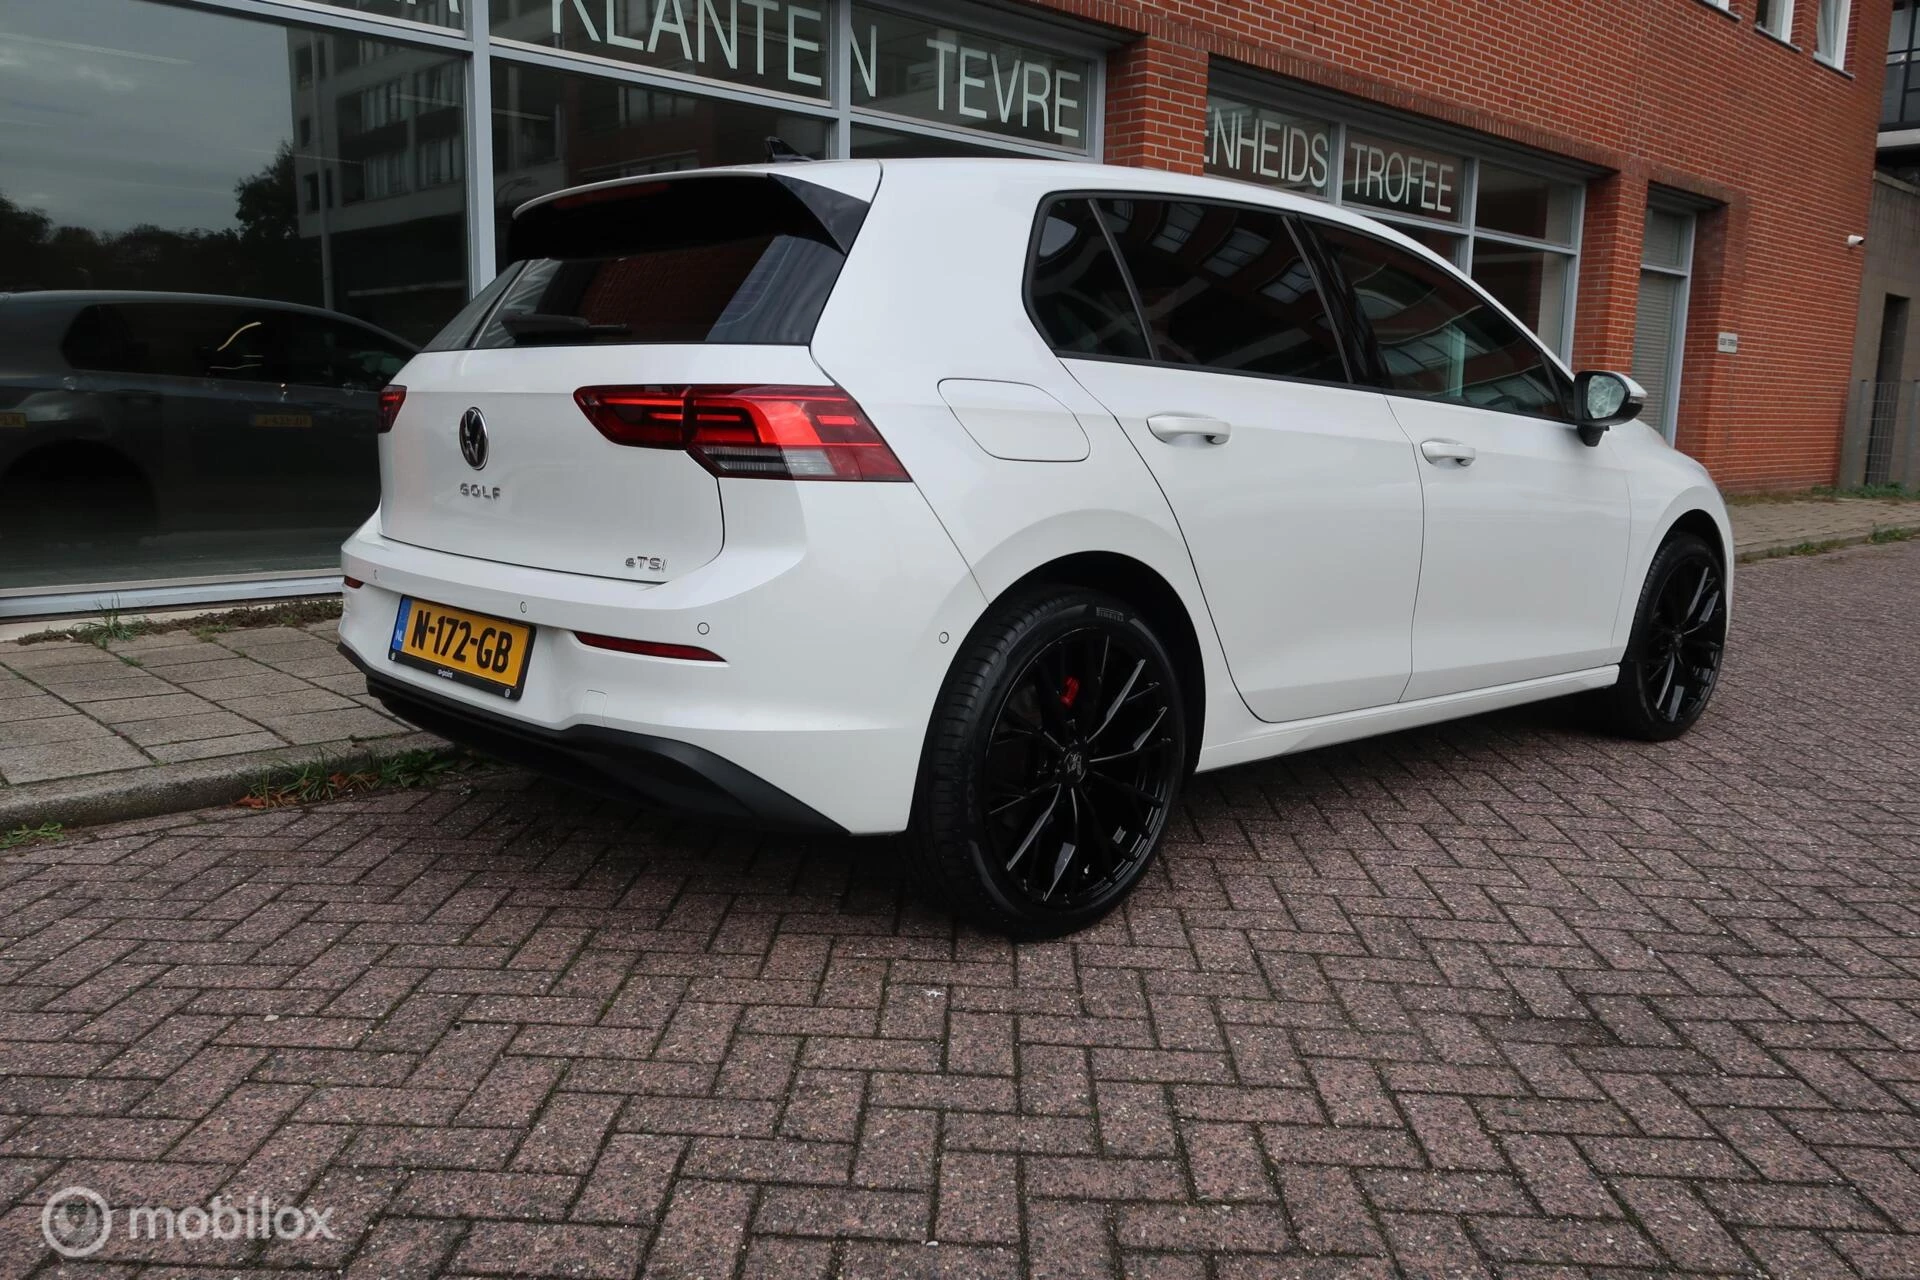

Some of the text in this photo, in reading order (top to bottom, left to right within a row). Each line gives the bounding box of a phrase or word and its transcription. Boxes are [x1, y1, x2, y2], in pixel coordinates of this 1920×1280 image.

[926, 38, 1081, 138] TEVRE
[1204, 104, 1454, 213] NHEIDS TROFEE
[460, 482, 501, 500] GOLF
[411, 609, 513, 673] N-172-GB
